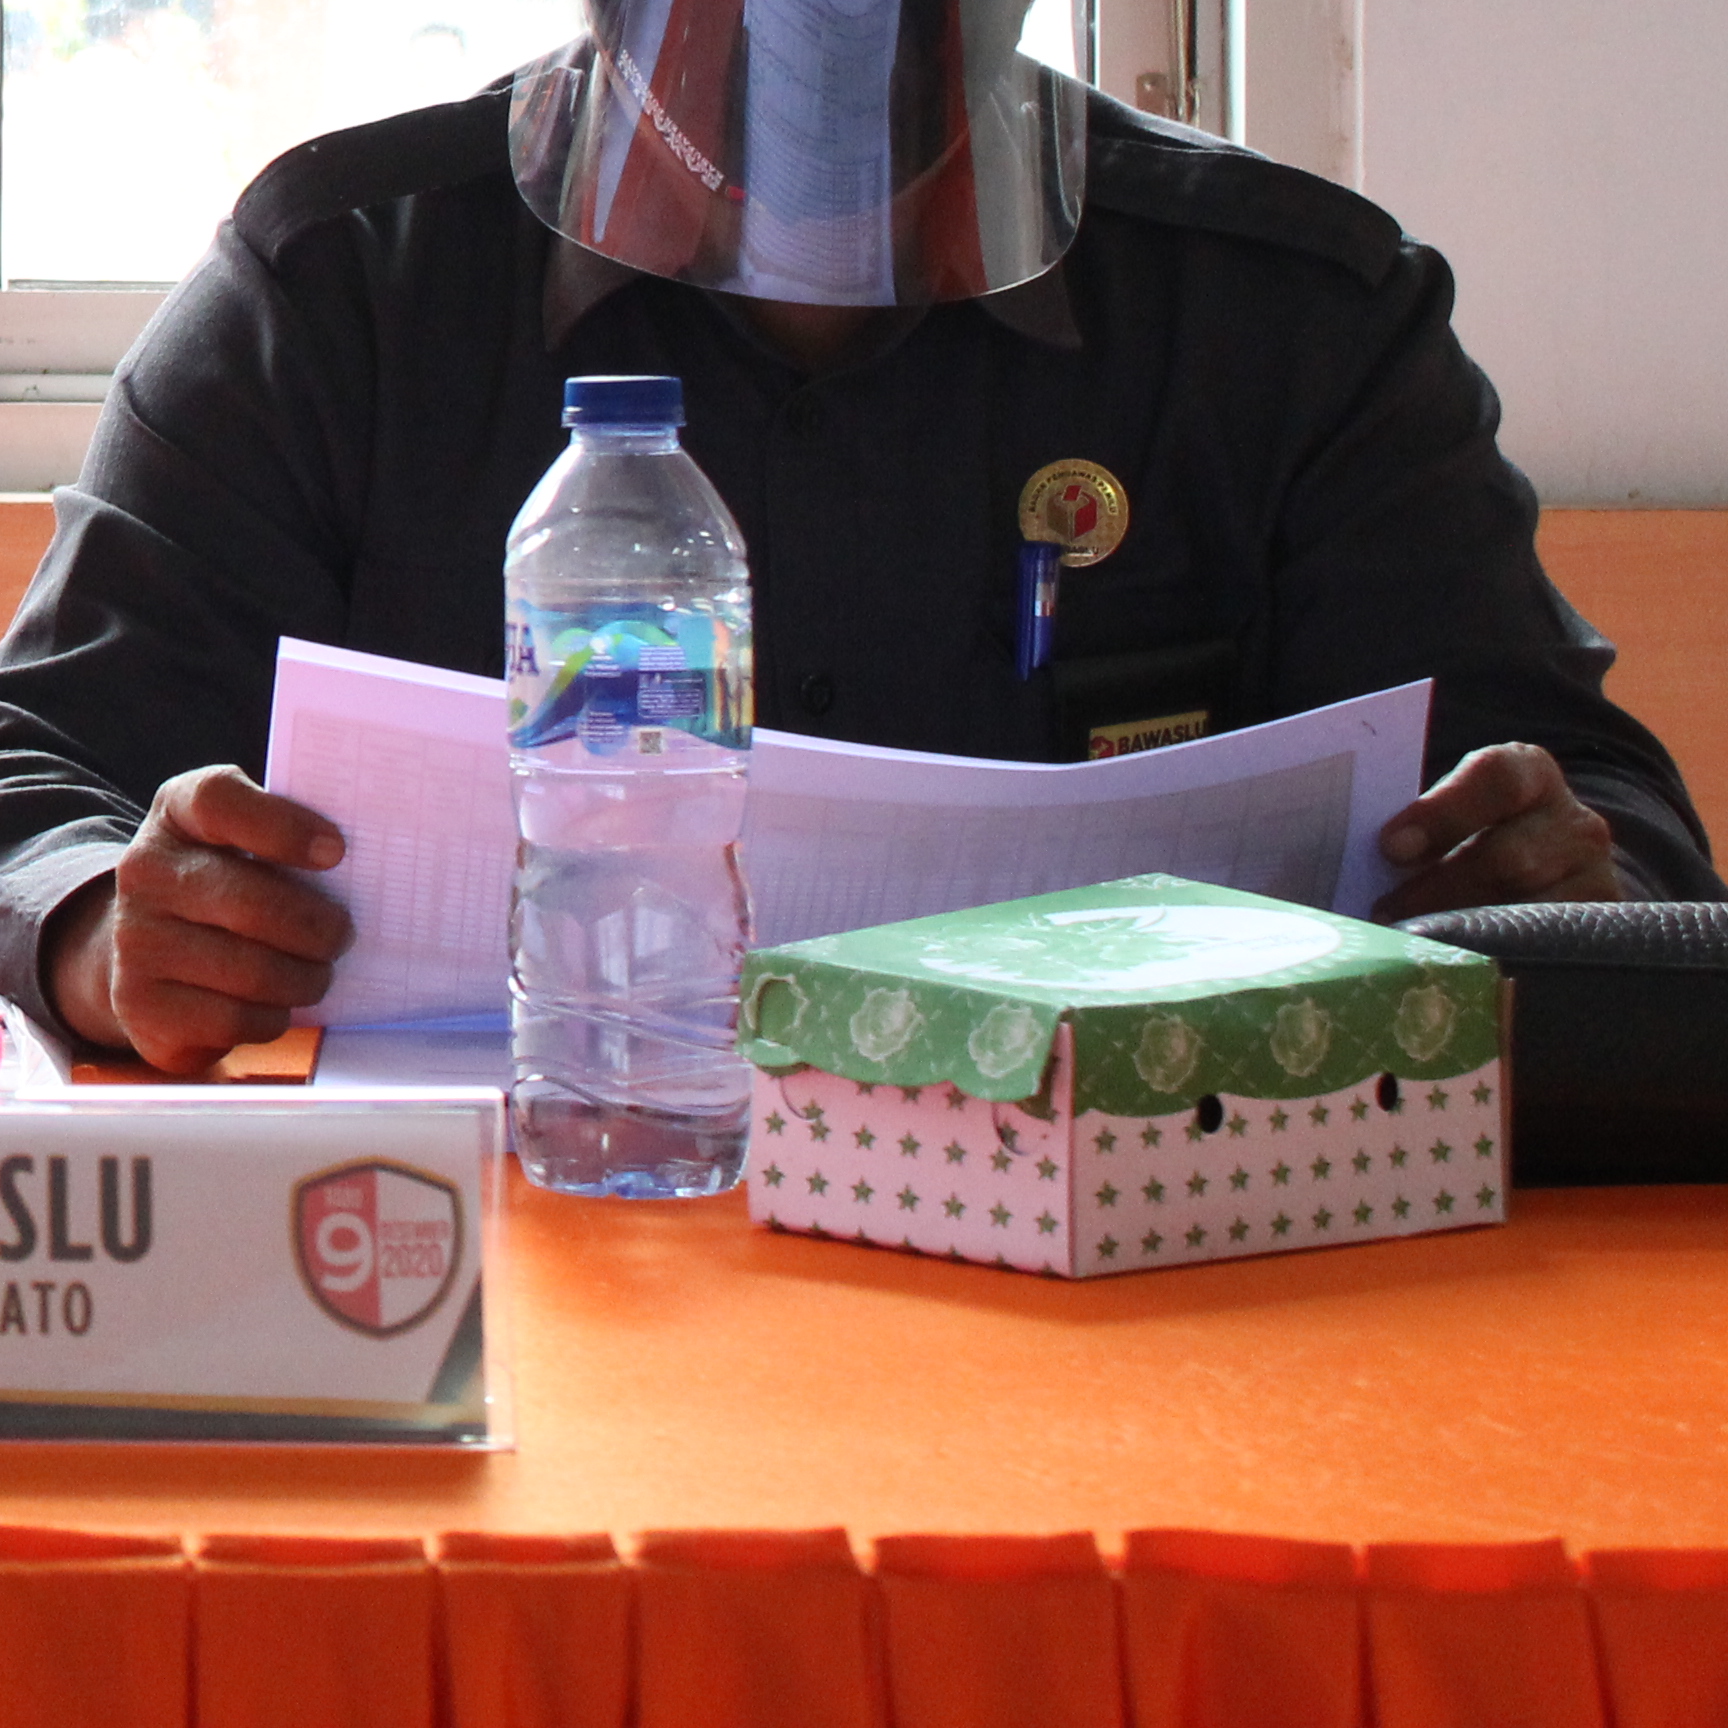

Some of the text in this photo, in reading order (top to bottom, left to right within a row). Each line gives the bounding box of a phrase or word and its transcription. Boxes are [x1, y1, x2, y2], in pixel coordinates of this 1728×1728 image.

[1117, 720, 1206, 754] BAWASLU
[315, 1211, 374, 1293] 9
[380, 1243, 445, 1278] 2020
